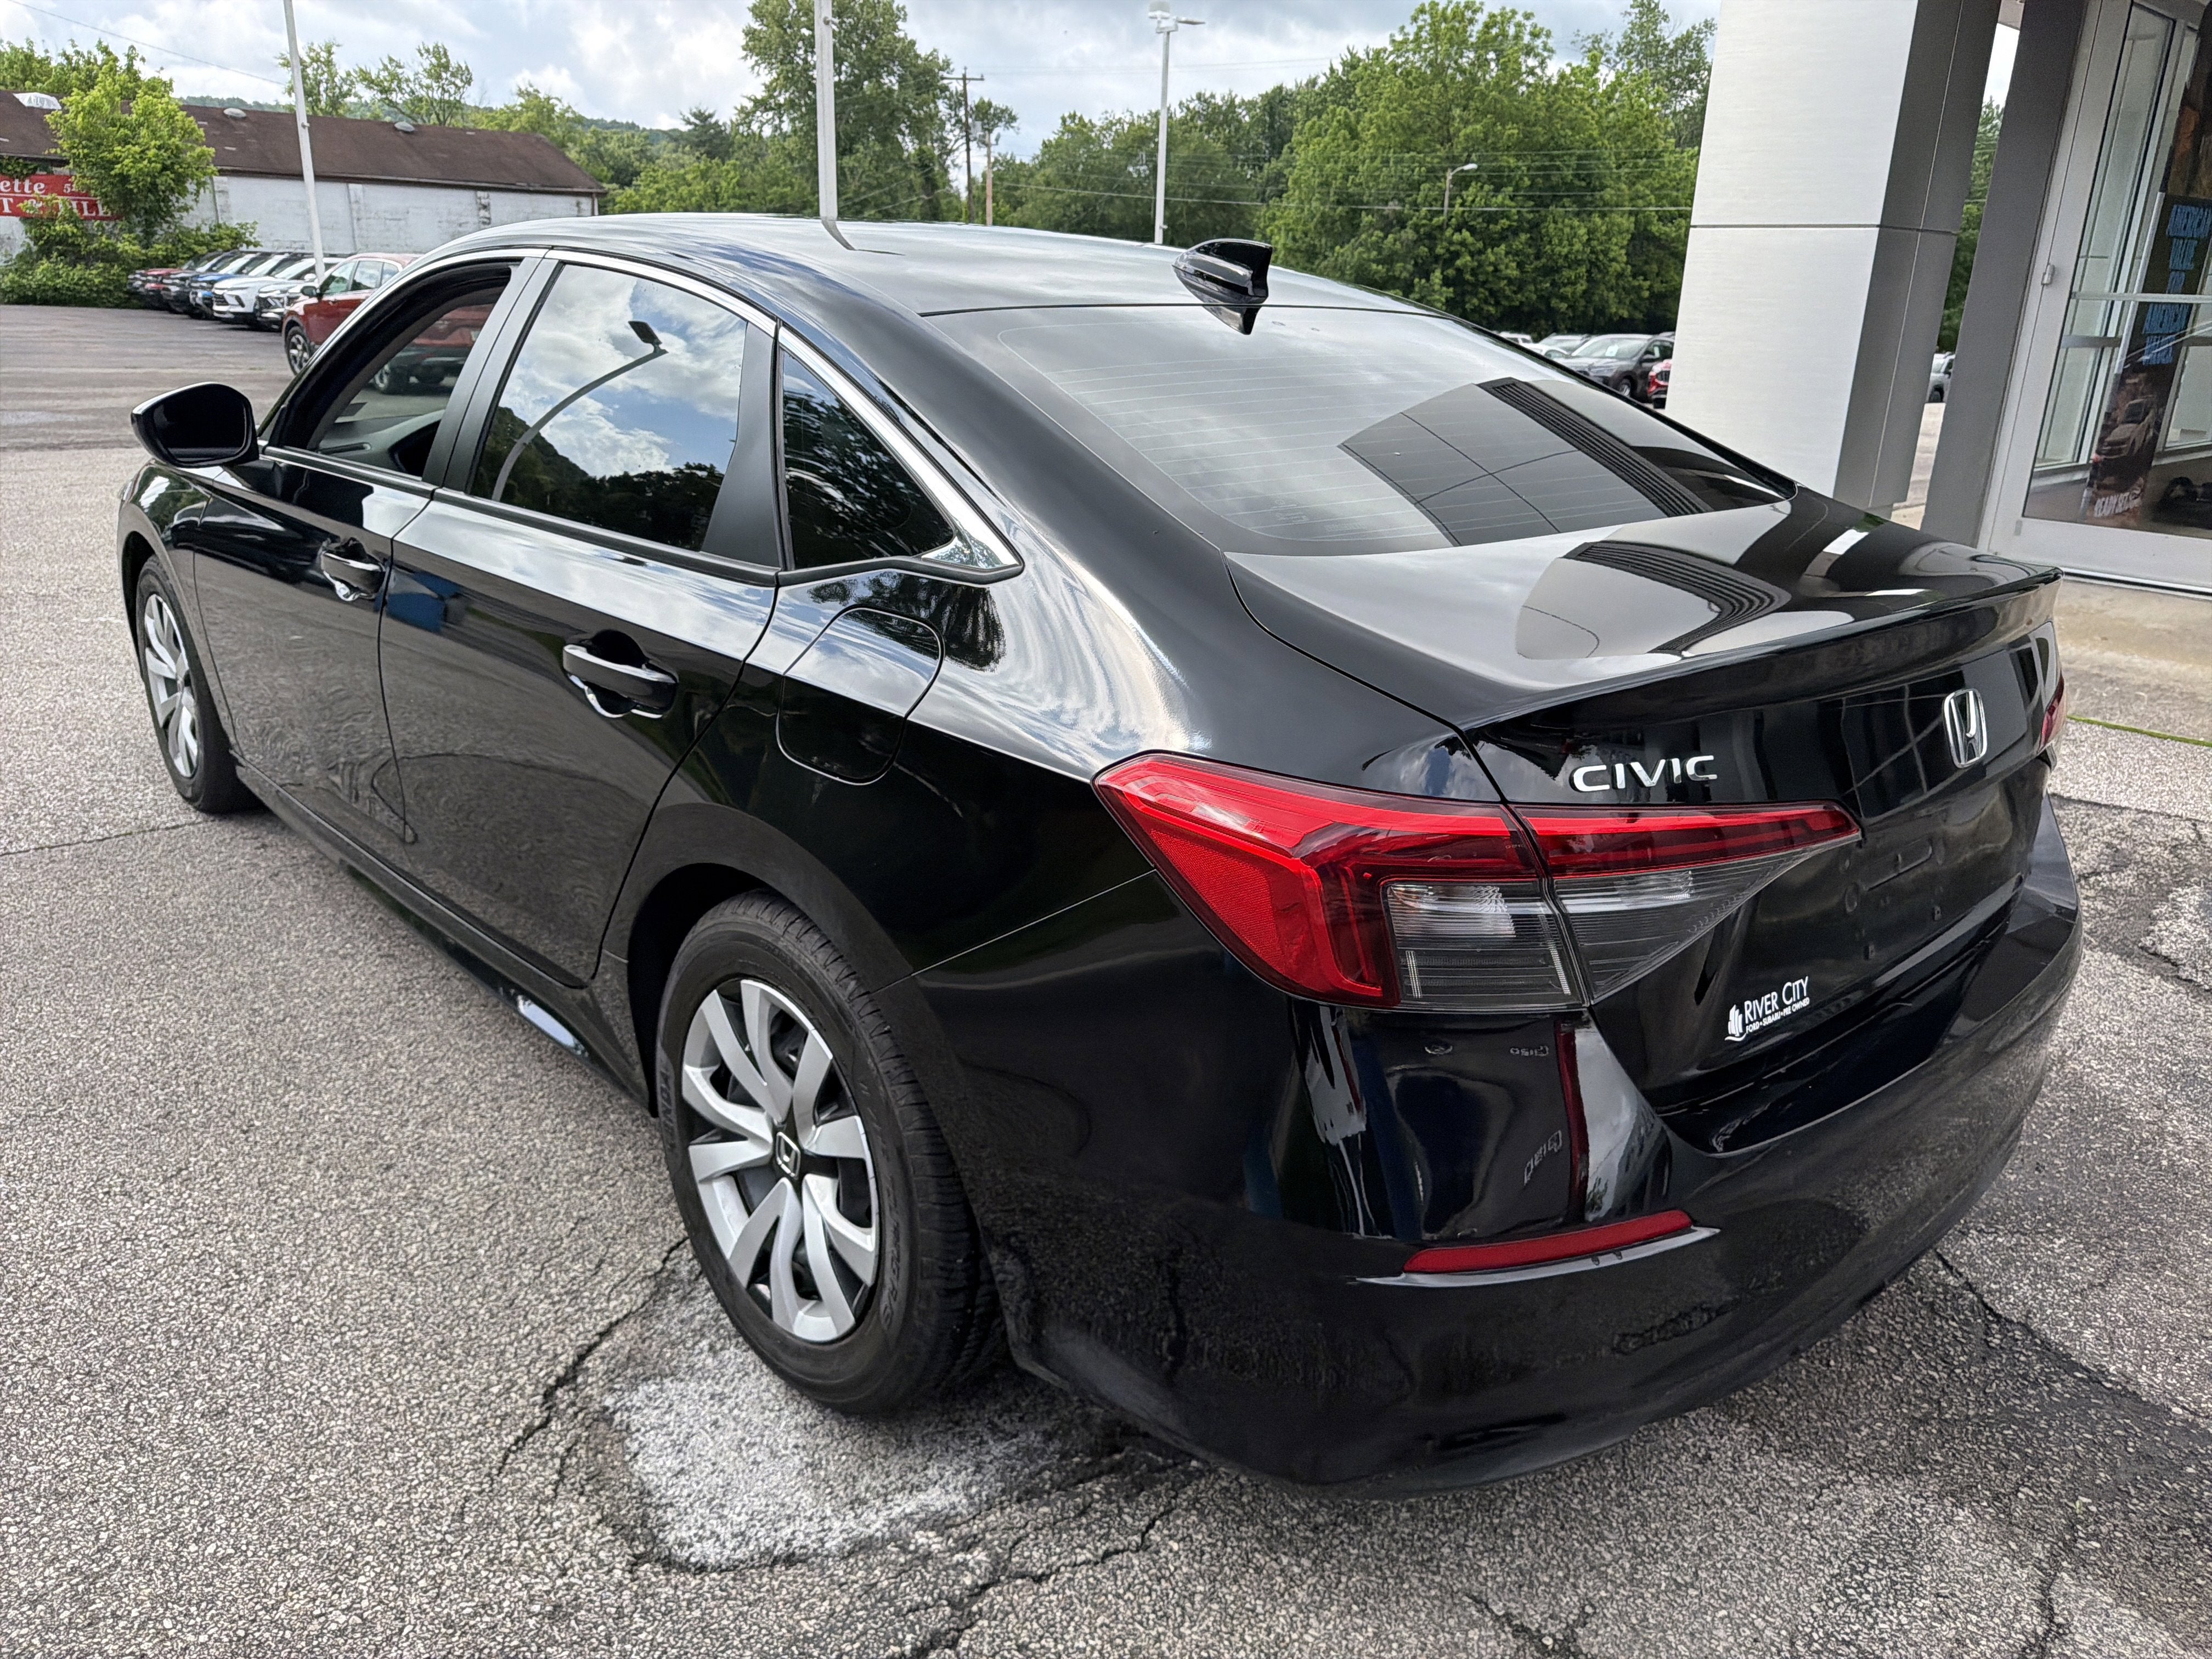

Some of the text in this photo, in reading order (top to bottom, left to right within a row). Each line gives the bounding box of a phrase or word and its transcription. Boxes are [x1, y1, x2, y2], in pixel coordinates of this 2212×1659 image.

[0, 179, 46, 194] ette
[1571, 755, 1717, 792] CIVIC
[1744, 975, 1809, 1024] RIVER CITY
[1792, 997, 1810, 1012] OWNED
